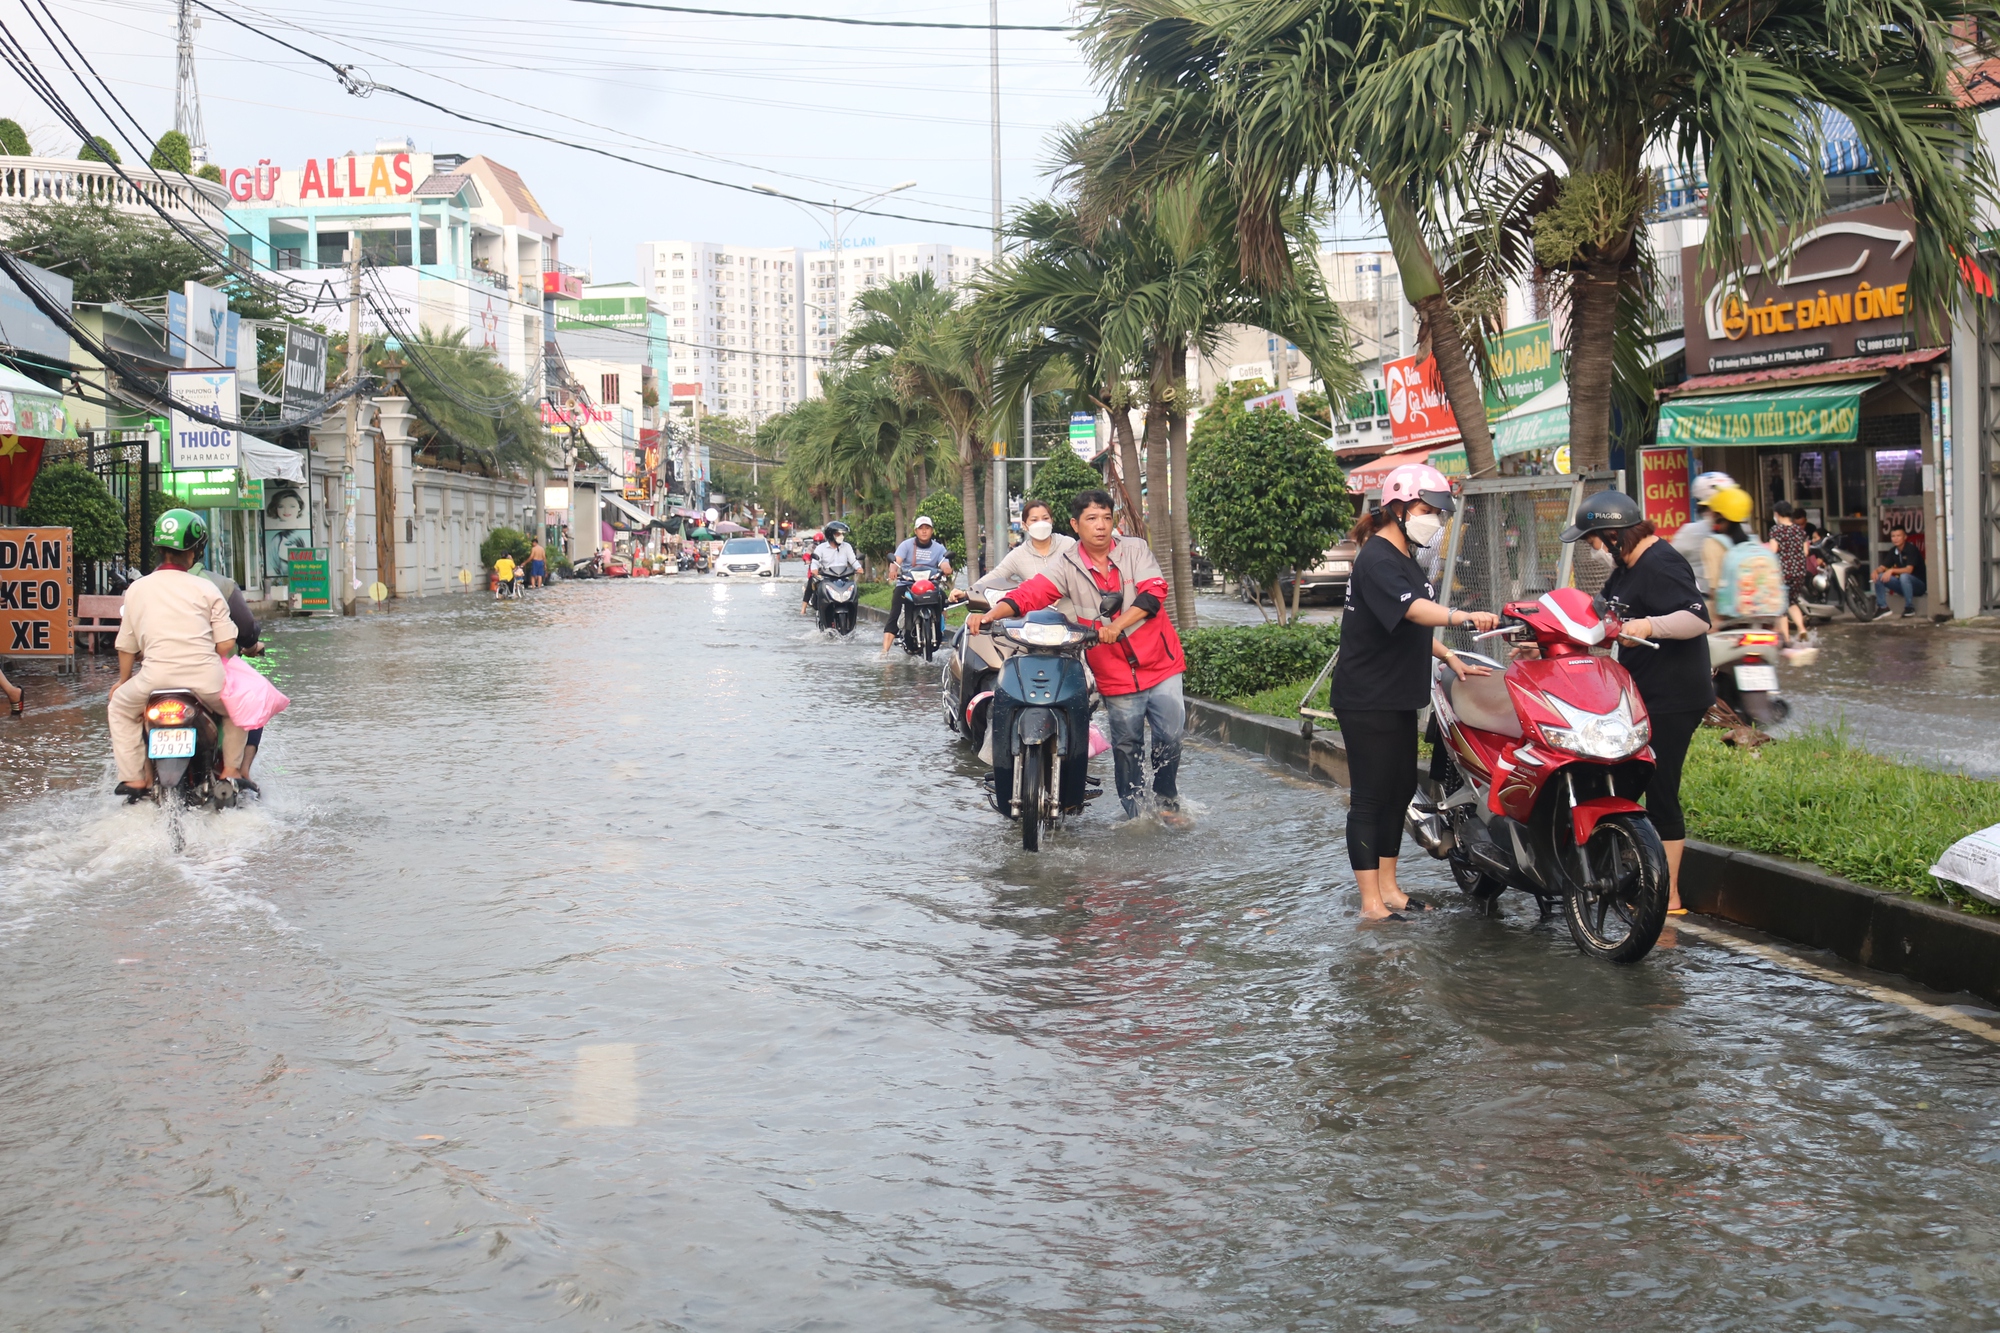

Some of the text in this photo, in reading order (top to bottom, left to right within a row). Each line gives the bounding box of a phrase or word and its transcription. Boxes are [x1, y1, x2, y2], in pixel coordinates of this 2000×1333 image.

[300, 153, 414, 199] ALLAS
[853, 236, 876, 248] LAN
[1748, 281, 1913, 336] TÓC ĐÀN ÔNG
[1516, 335, 1551, 375] NGÂN
[1723, 413, 1750, 443] TẠO
[1753, 401, 1784, 437] KIỂU
[1786, 404, 1817, 436] TÓC
[1818, 407, 1857, 435] BABY
[180, 453, 231, 462] PHARMACY
[1643, 451, 1688, 474] NHẬN
[1646, 479, 1686, 503] GIẶT
[1595, 512, 1622, 520] PIAGGIO
[1649, 507, 1686, 528] HẤP
[0, 533, 61, 570] DÁN
[0, 580, 61, 611] KEO
[10, 621, 50, 650] XE
[1518, 765, 1538, 778] HONDA
